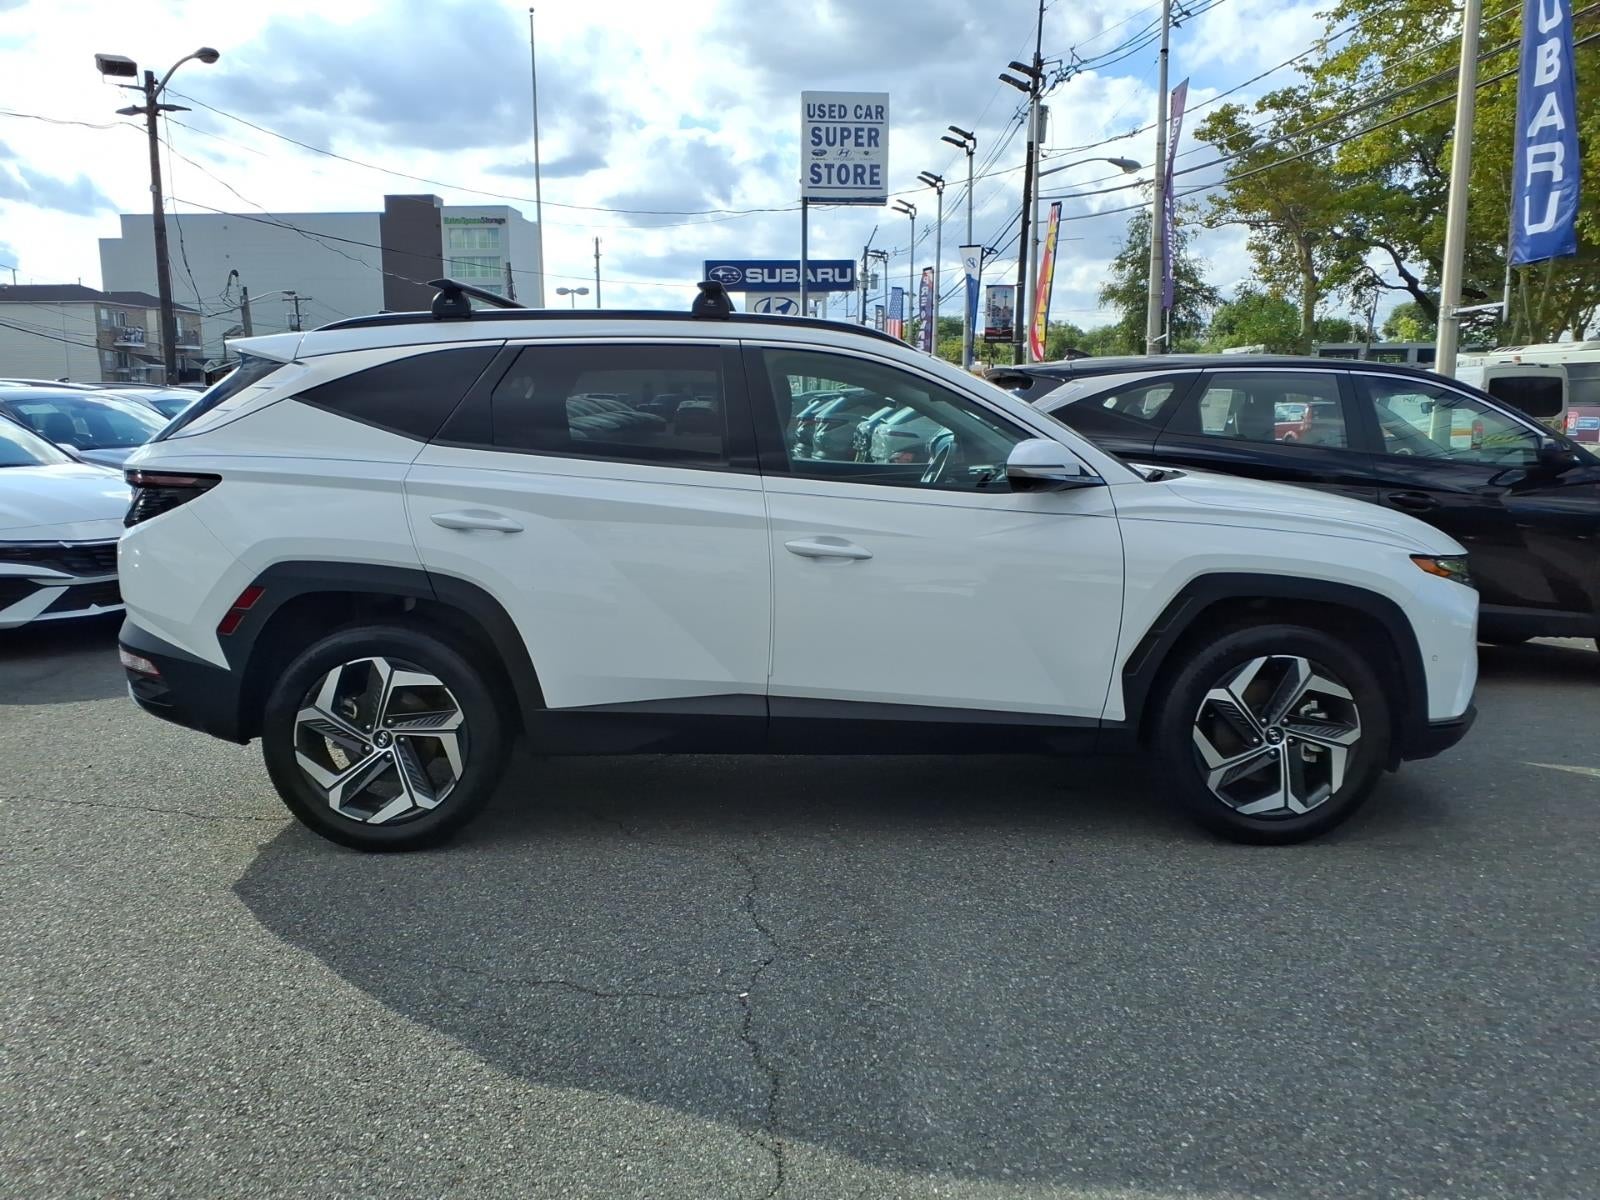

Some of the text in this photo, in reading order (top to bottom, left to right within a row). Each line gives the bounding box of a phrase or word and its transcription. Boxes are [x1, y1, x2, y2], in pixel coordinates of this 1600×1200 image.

[807, 103, 884, 121] USED CAR
[811, 126, 880, 148] SUPER
[809, 163, 881, 186] STORE
[746, 268, 851, 283] SUBARU
